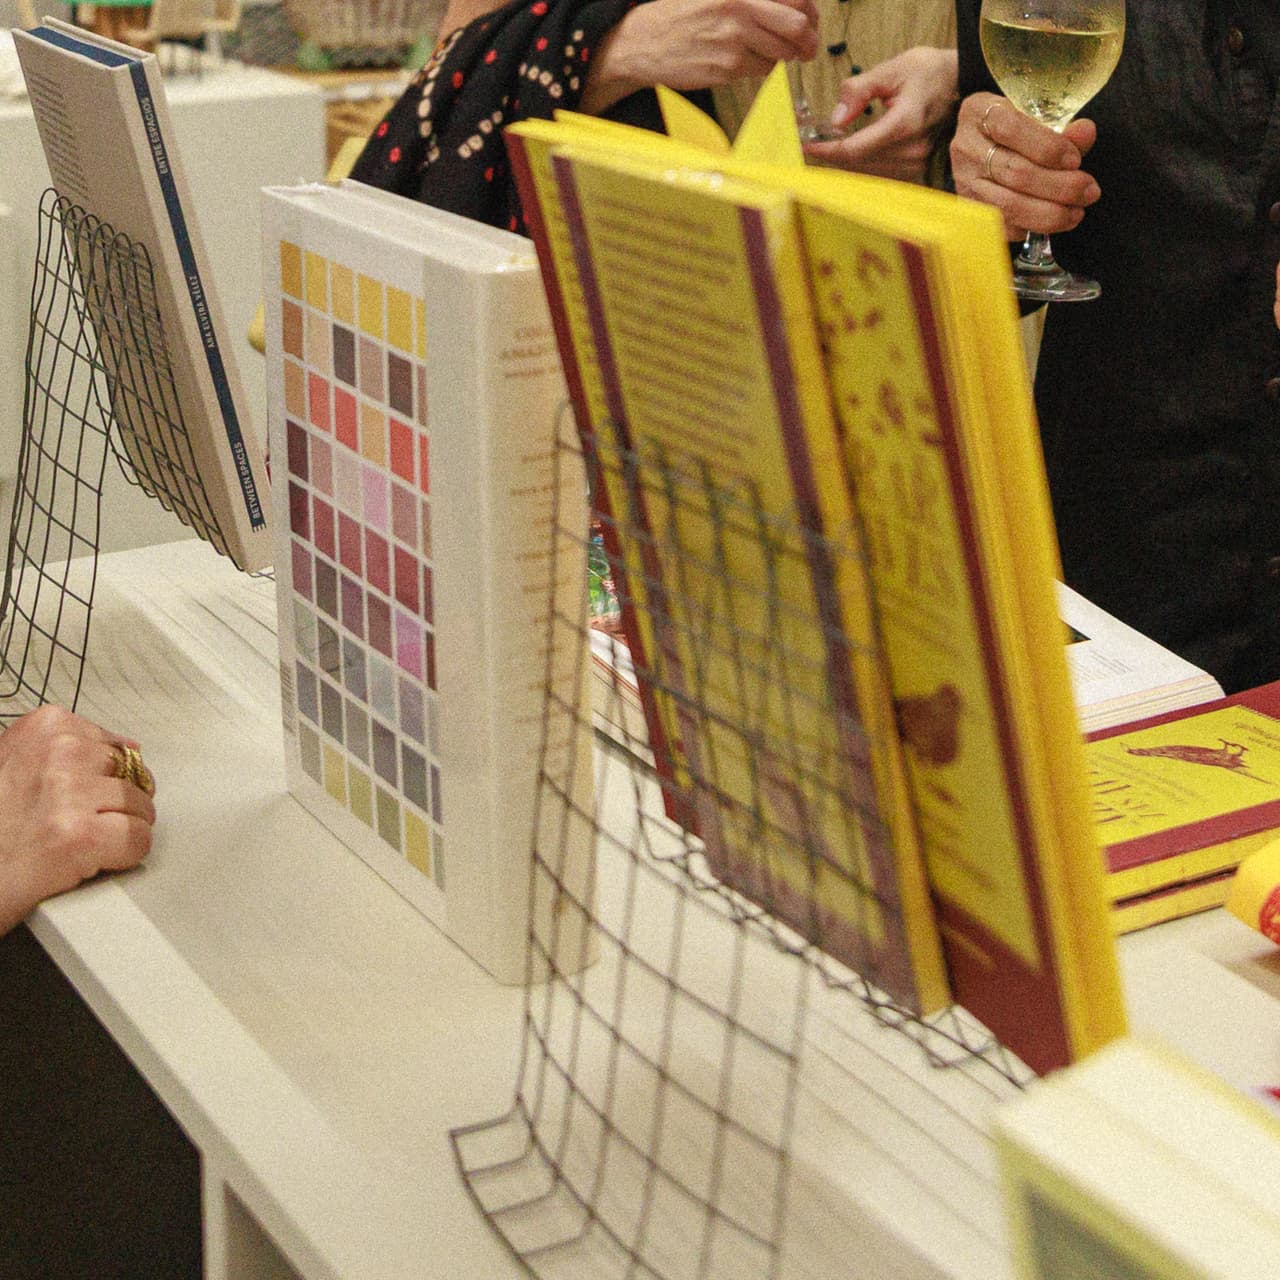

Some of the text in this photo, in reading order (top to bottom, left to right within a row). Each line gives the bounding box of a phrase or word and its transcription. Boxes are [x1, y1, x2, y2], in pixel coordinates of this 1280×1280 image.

[140, 96, 169, 175] ENTRE ESPACIOS
[233, 441, 261, 519] BETWEEN SPACES
